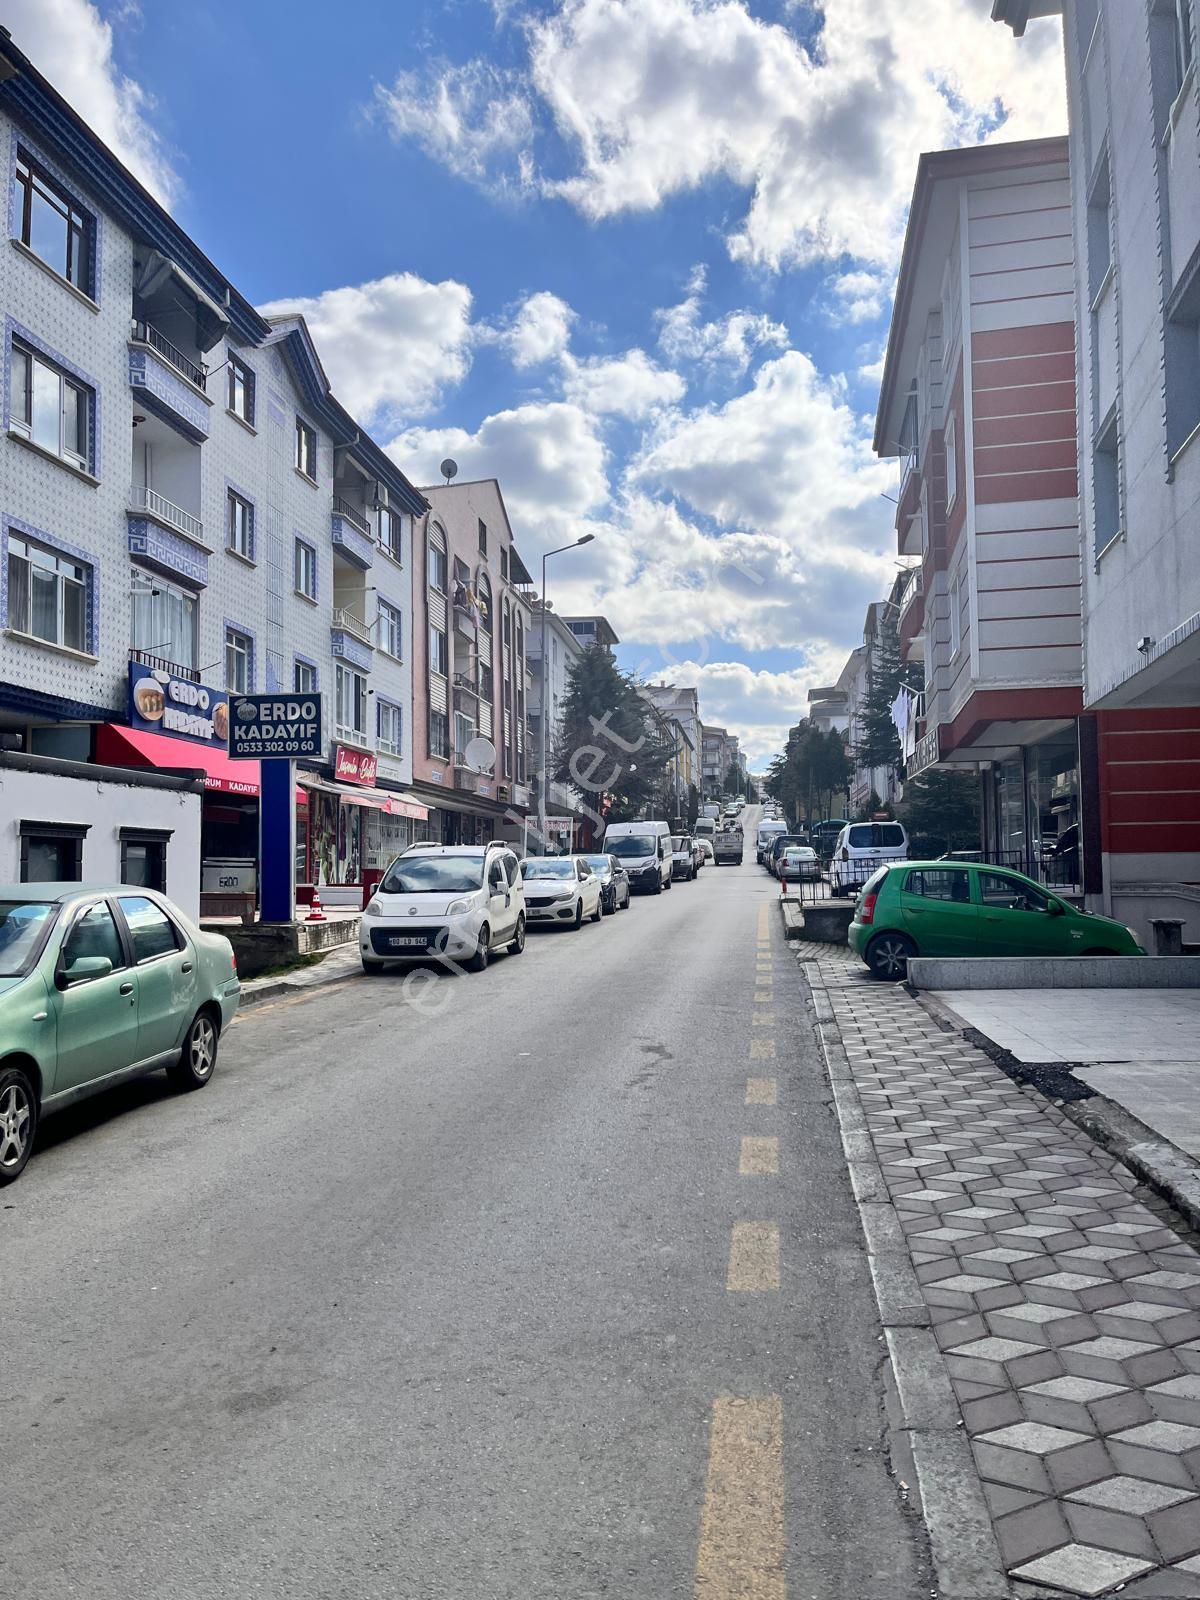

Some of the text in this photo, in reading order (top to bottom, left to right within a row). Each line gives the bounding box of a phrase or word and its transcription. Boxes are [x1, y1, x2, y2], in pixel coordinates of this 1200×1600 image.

[168, 681, 210, 710] ERDO
[260, 702, 317, 721] ERDO
[234, 723, 318, 740] KADAYIF
[237, 740, 315, 753] 0533 302 09 60
[228, 781, 258, 793] KADAYIF
